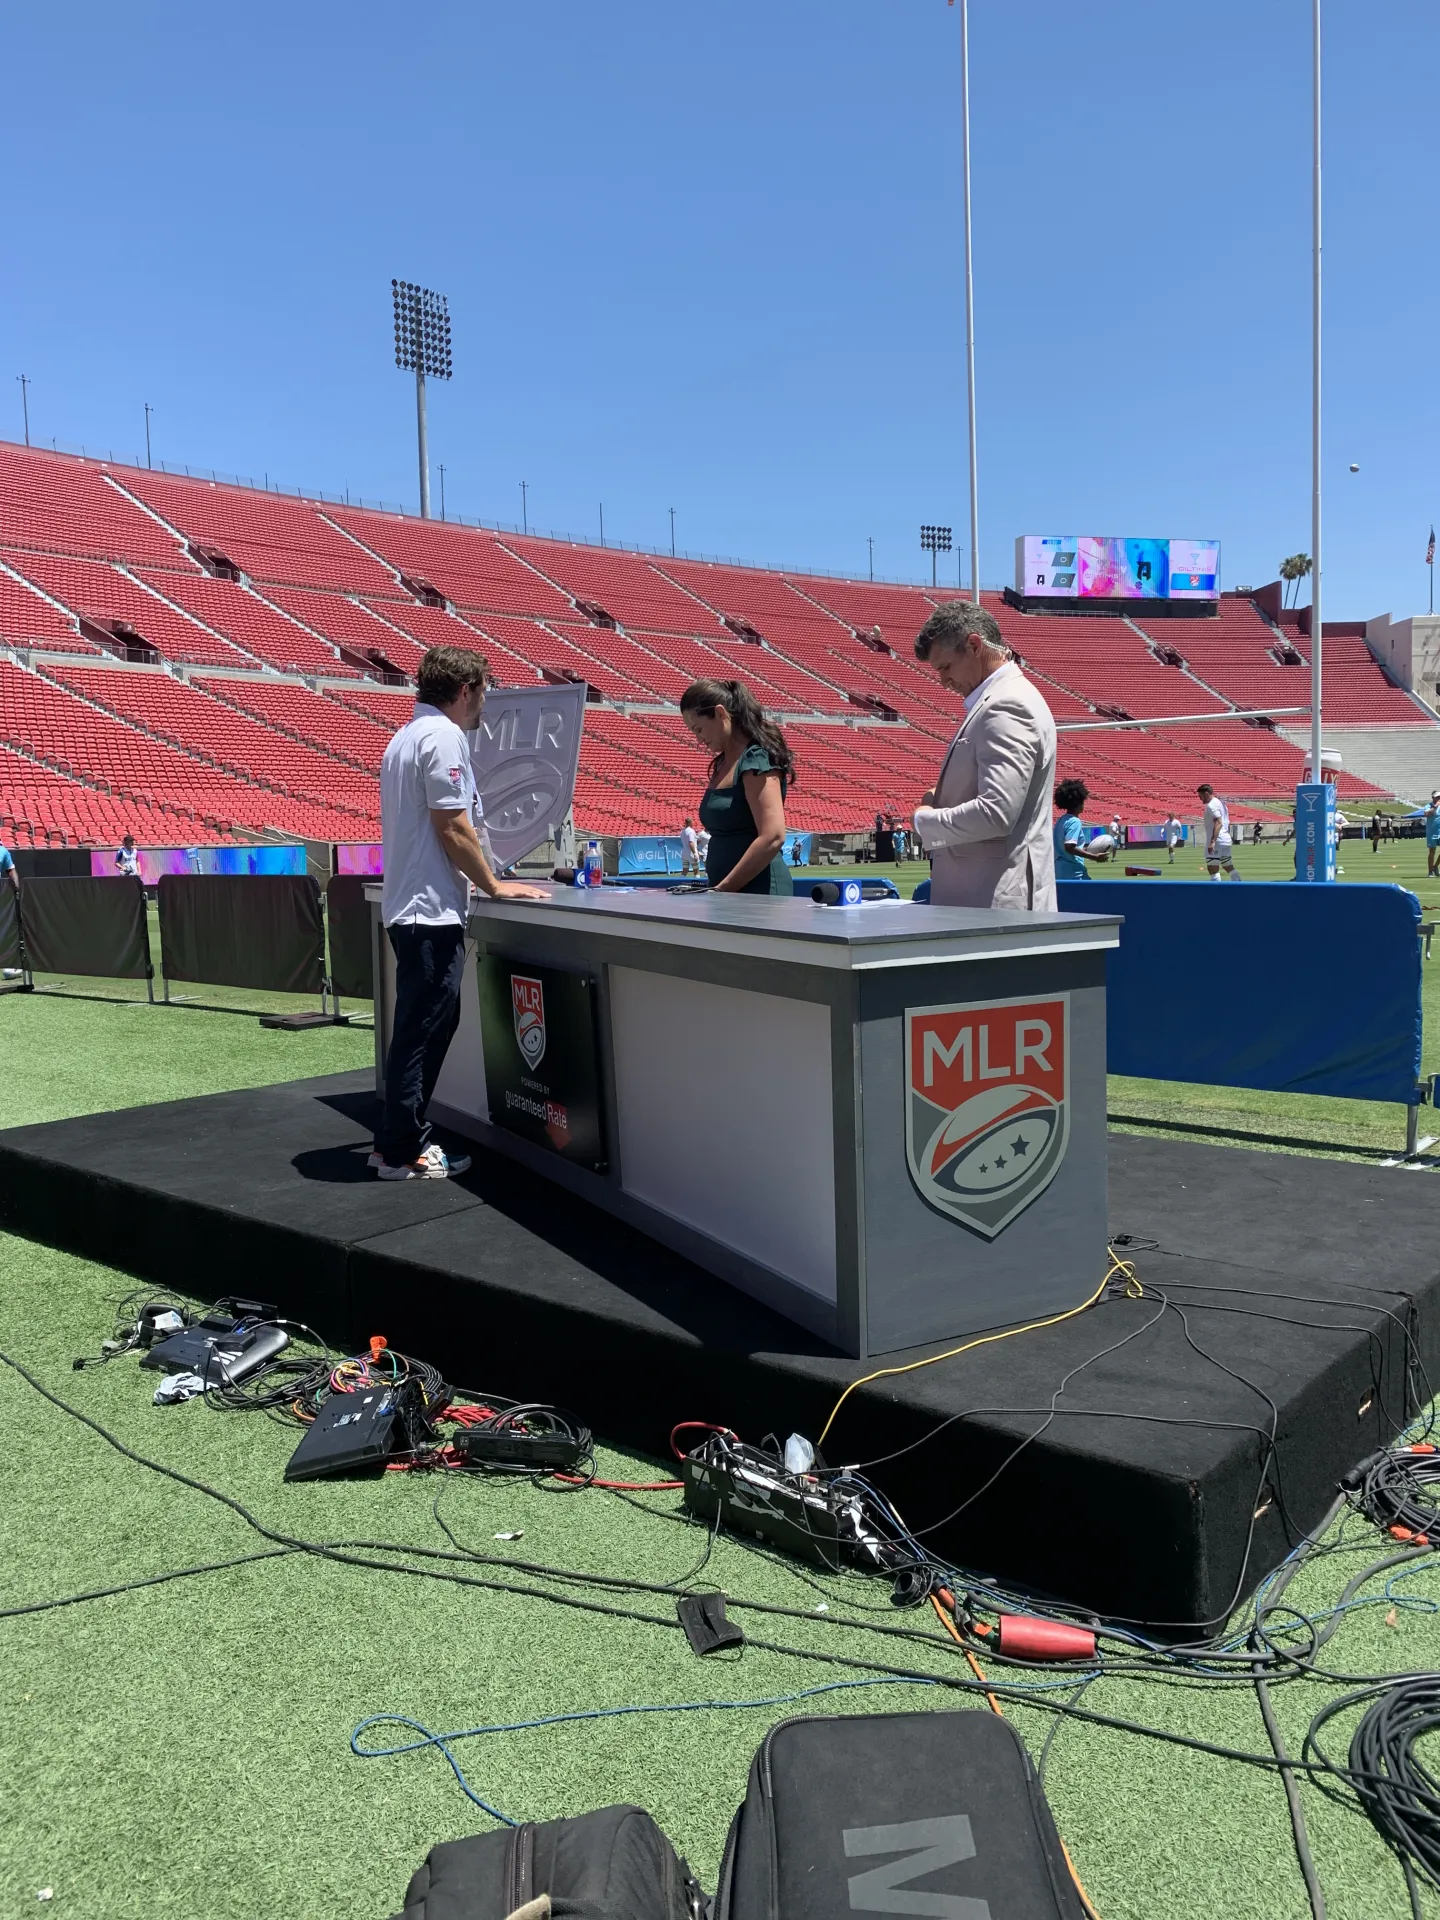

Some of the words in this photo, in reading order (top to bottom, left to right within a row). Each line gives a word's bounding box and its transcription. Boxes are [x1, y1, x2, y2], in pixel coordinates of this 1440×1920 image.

[474, 707, 564, 752] MLR
[637, 849, 682, 862] @GILIN
[514, 983, 541, 1012] MLR
[923, 1019, 1054, 1087] MLR
[520, 1076, 543, 1093] POWERED
[543, 1086, 550, 1095] BY
